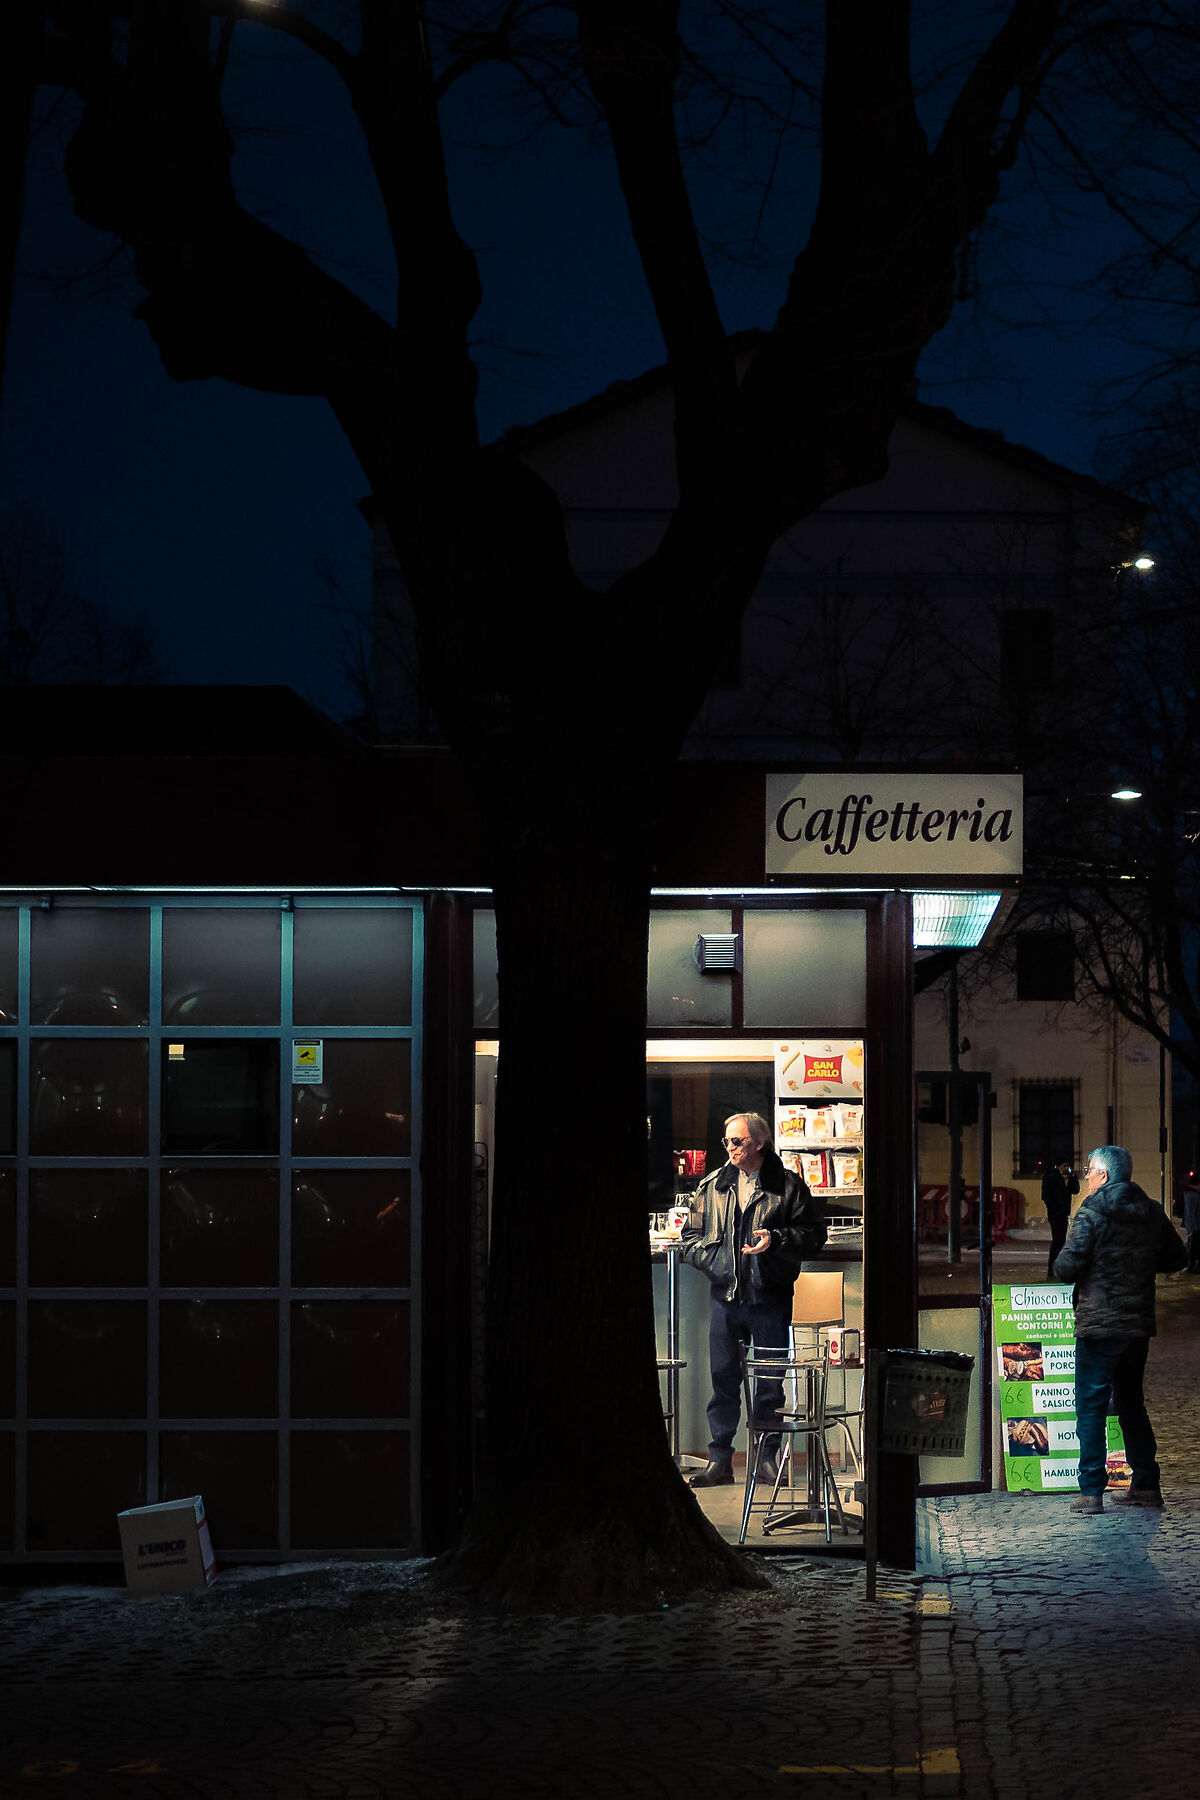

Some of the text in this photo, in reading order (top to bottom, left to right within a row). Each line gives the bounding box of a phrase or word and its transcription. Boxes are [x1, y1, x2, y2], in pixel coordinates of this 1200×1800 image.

[775, 794, 1013, 855] Caffetteria
[812, 1061, 834, 1070] SAN
[807, 1069, 839, 1078] CARLO
[1014, 1288, 1058, 1308] Chiosco
[1001, 1313, 1033, 1321] PANINI
[1035, 1312, 1062, 1320] CALDI
[1017, 1322, 1063, 1330] CONTORNI
[1035, 1388, 1070, 1396] PANINO
[1057, 1432, 1075, 1440] HOT
[138, 1540, 186, 1556] L'UNICO
